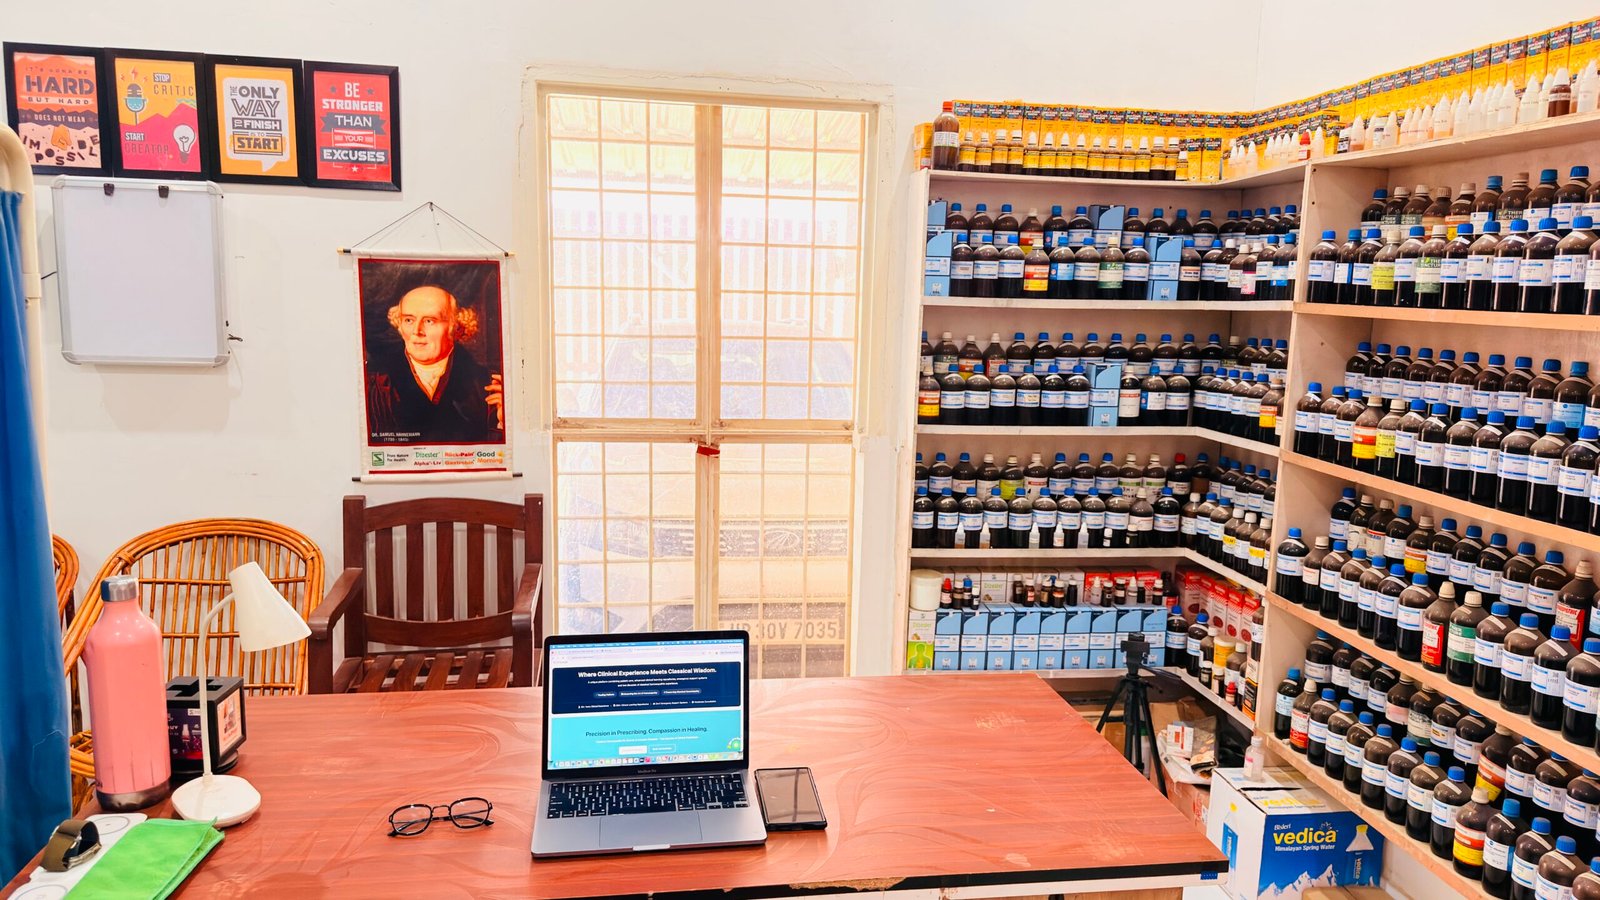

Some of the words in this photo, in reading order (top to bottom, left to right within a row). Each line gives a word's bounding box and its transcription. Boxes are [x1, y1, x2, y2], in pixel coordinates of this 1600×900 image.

[154, 73, 170, 82] STOP
[25, 75, 95, 95] HARD
[153, 84, 194, 96] CRITIC
[344, 82, 360, 98] BE
[230, 85, 238, 96] THE
[239, 86, 279, 99] ONLY
[231, 98, 280, 117] WAY
[322, 99, 383, 112] STRONGER
[34, 113, 51, 122] DOES
[52, 114, 65, 122] NOT
[67, 115, 86, 123] MEAN
[335, 115, 372, 127] THAN
[234, 119, 243, 128] TO
[244, 119, 280, 130] FINISH
[125, 132, 145, 141] START
[124, 143, 169, 155] CREATOR
[237, 136, 279, 150] START
[323, 149, 386, 162] EXCUSES
[794, 621, 838, 639] 7035
[619, 669, 650, 677] Experience
[648, 727, 681, 735] Compassion
[1273, 827, 1337, 845] vedica
[1302, 844, 1319, 852] Spring
